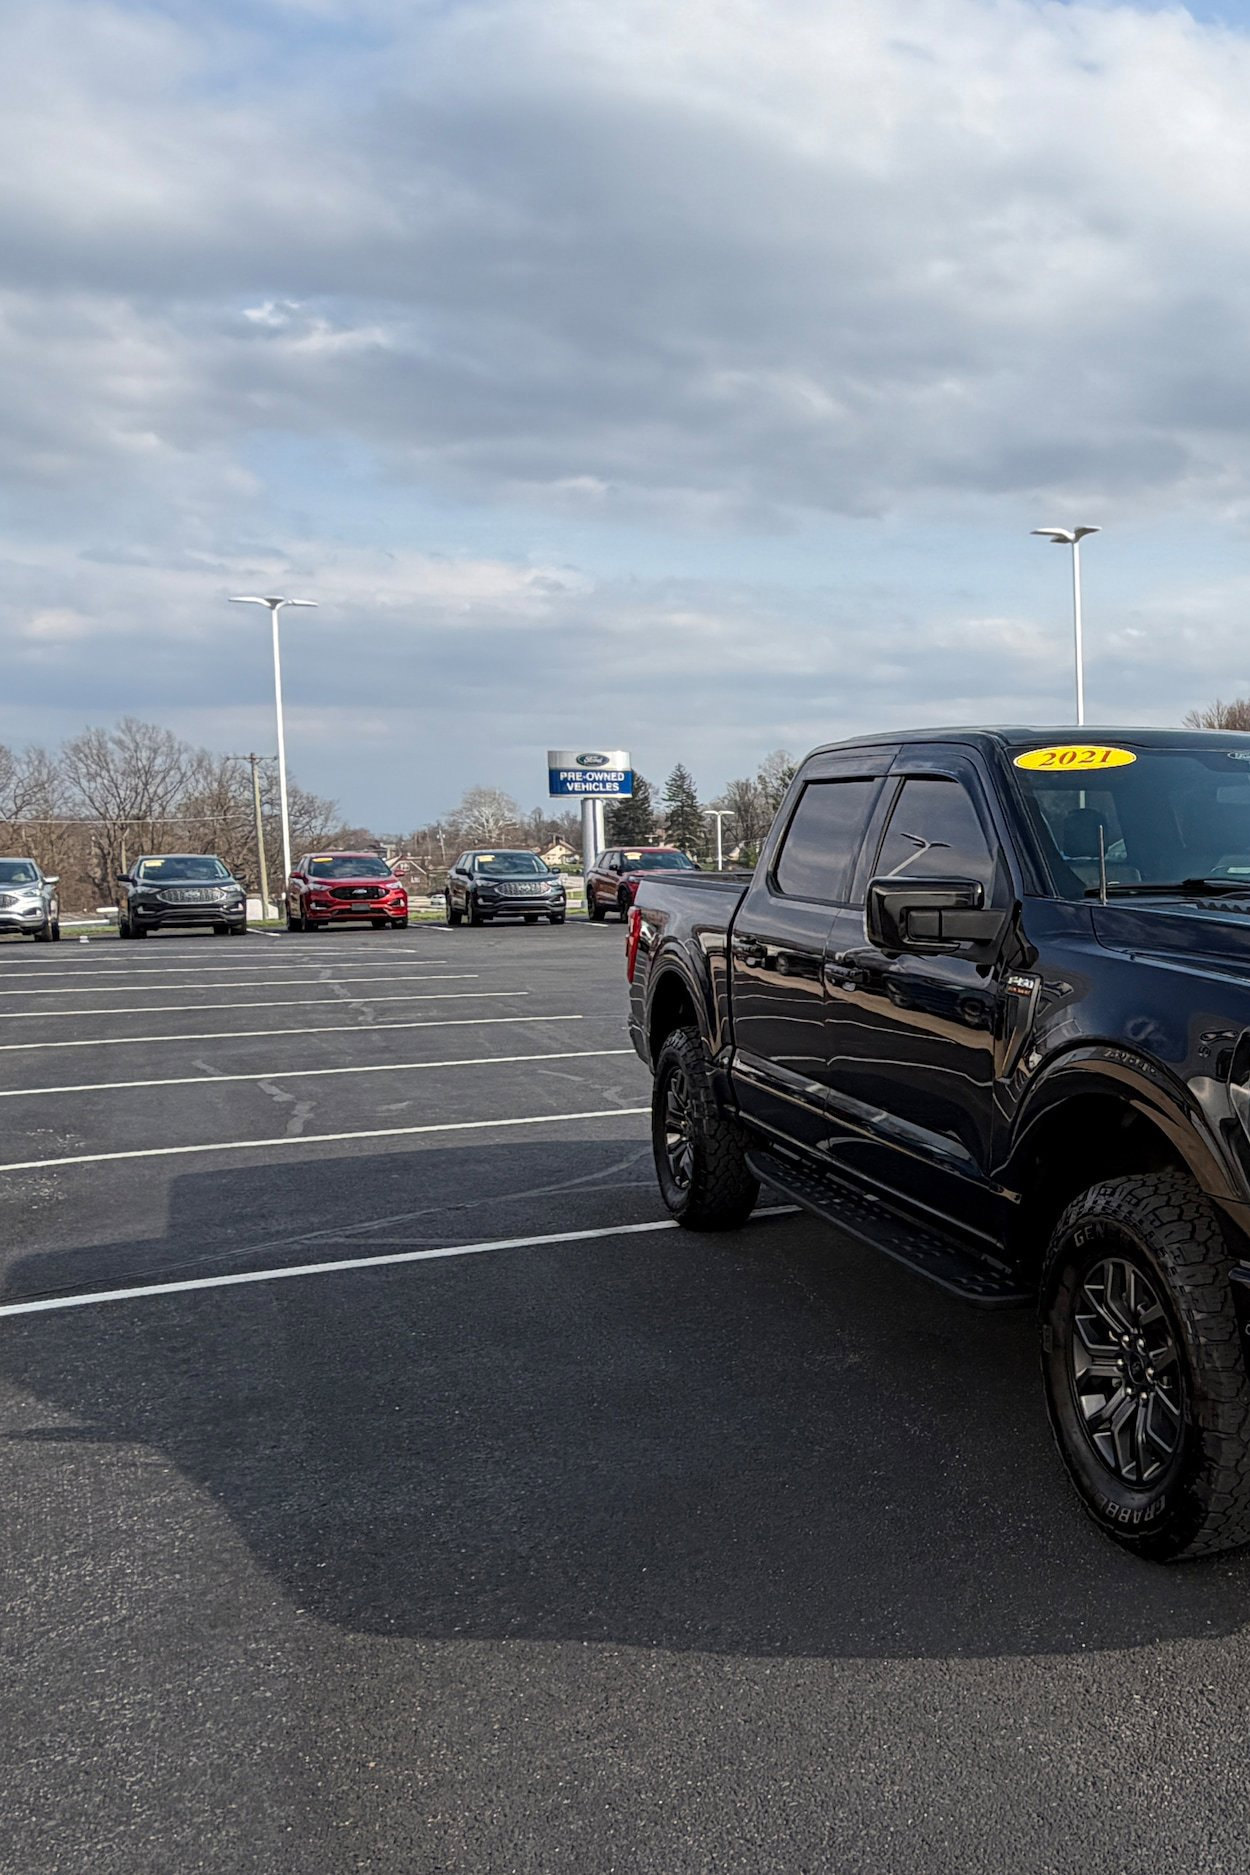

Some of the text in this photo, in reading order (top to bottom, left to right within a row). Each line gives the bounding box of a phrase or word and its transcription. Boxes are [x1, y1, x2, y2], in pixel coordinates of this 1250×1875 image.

[1038, 750, 1112, 767] 2021
[560, 771, 625, 781] PRE-OWNED
[566, 782, 620, 791] VEHICLES
